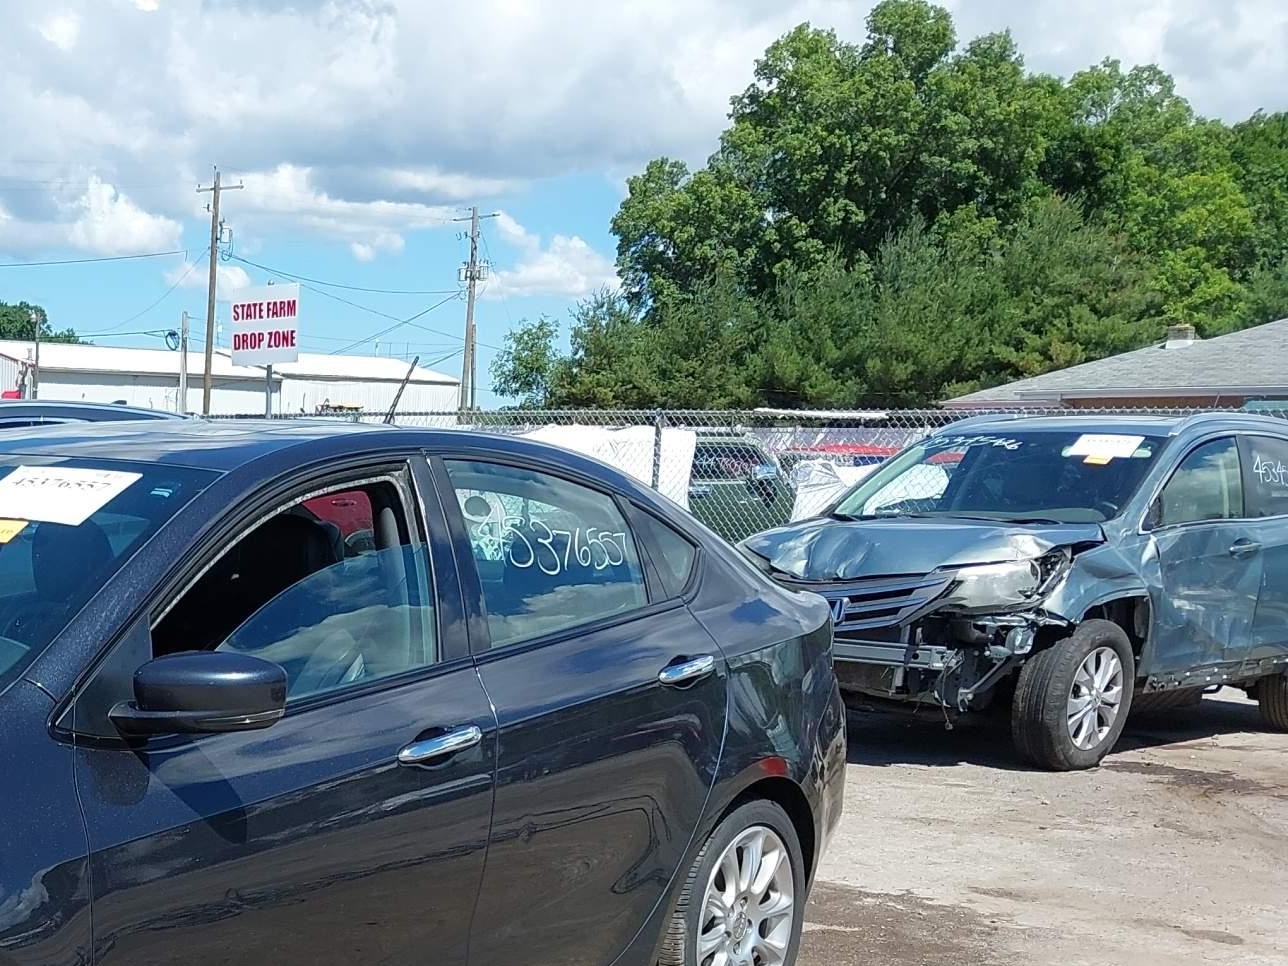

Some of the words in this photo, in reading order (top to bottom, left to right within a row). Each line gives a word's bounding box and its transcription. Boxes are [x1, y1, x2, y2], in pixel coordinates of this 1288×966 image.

[233, 302, 264, 321] STATE
[266, 299, 297, 319] FARM
[233, 331, 265, 351] DROP
[267, 329, 296, 349] ZONE
[477, 502, 627, 575] 45376557
